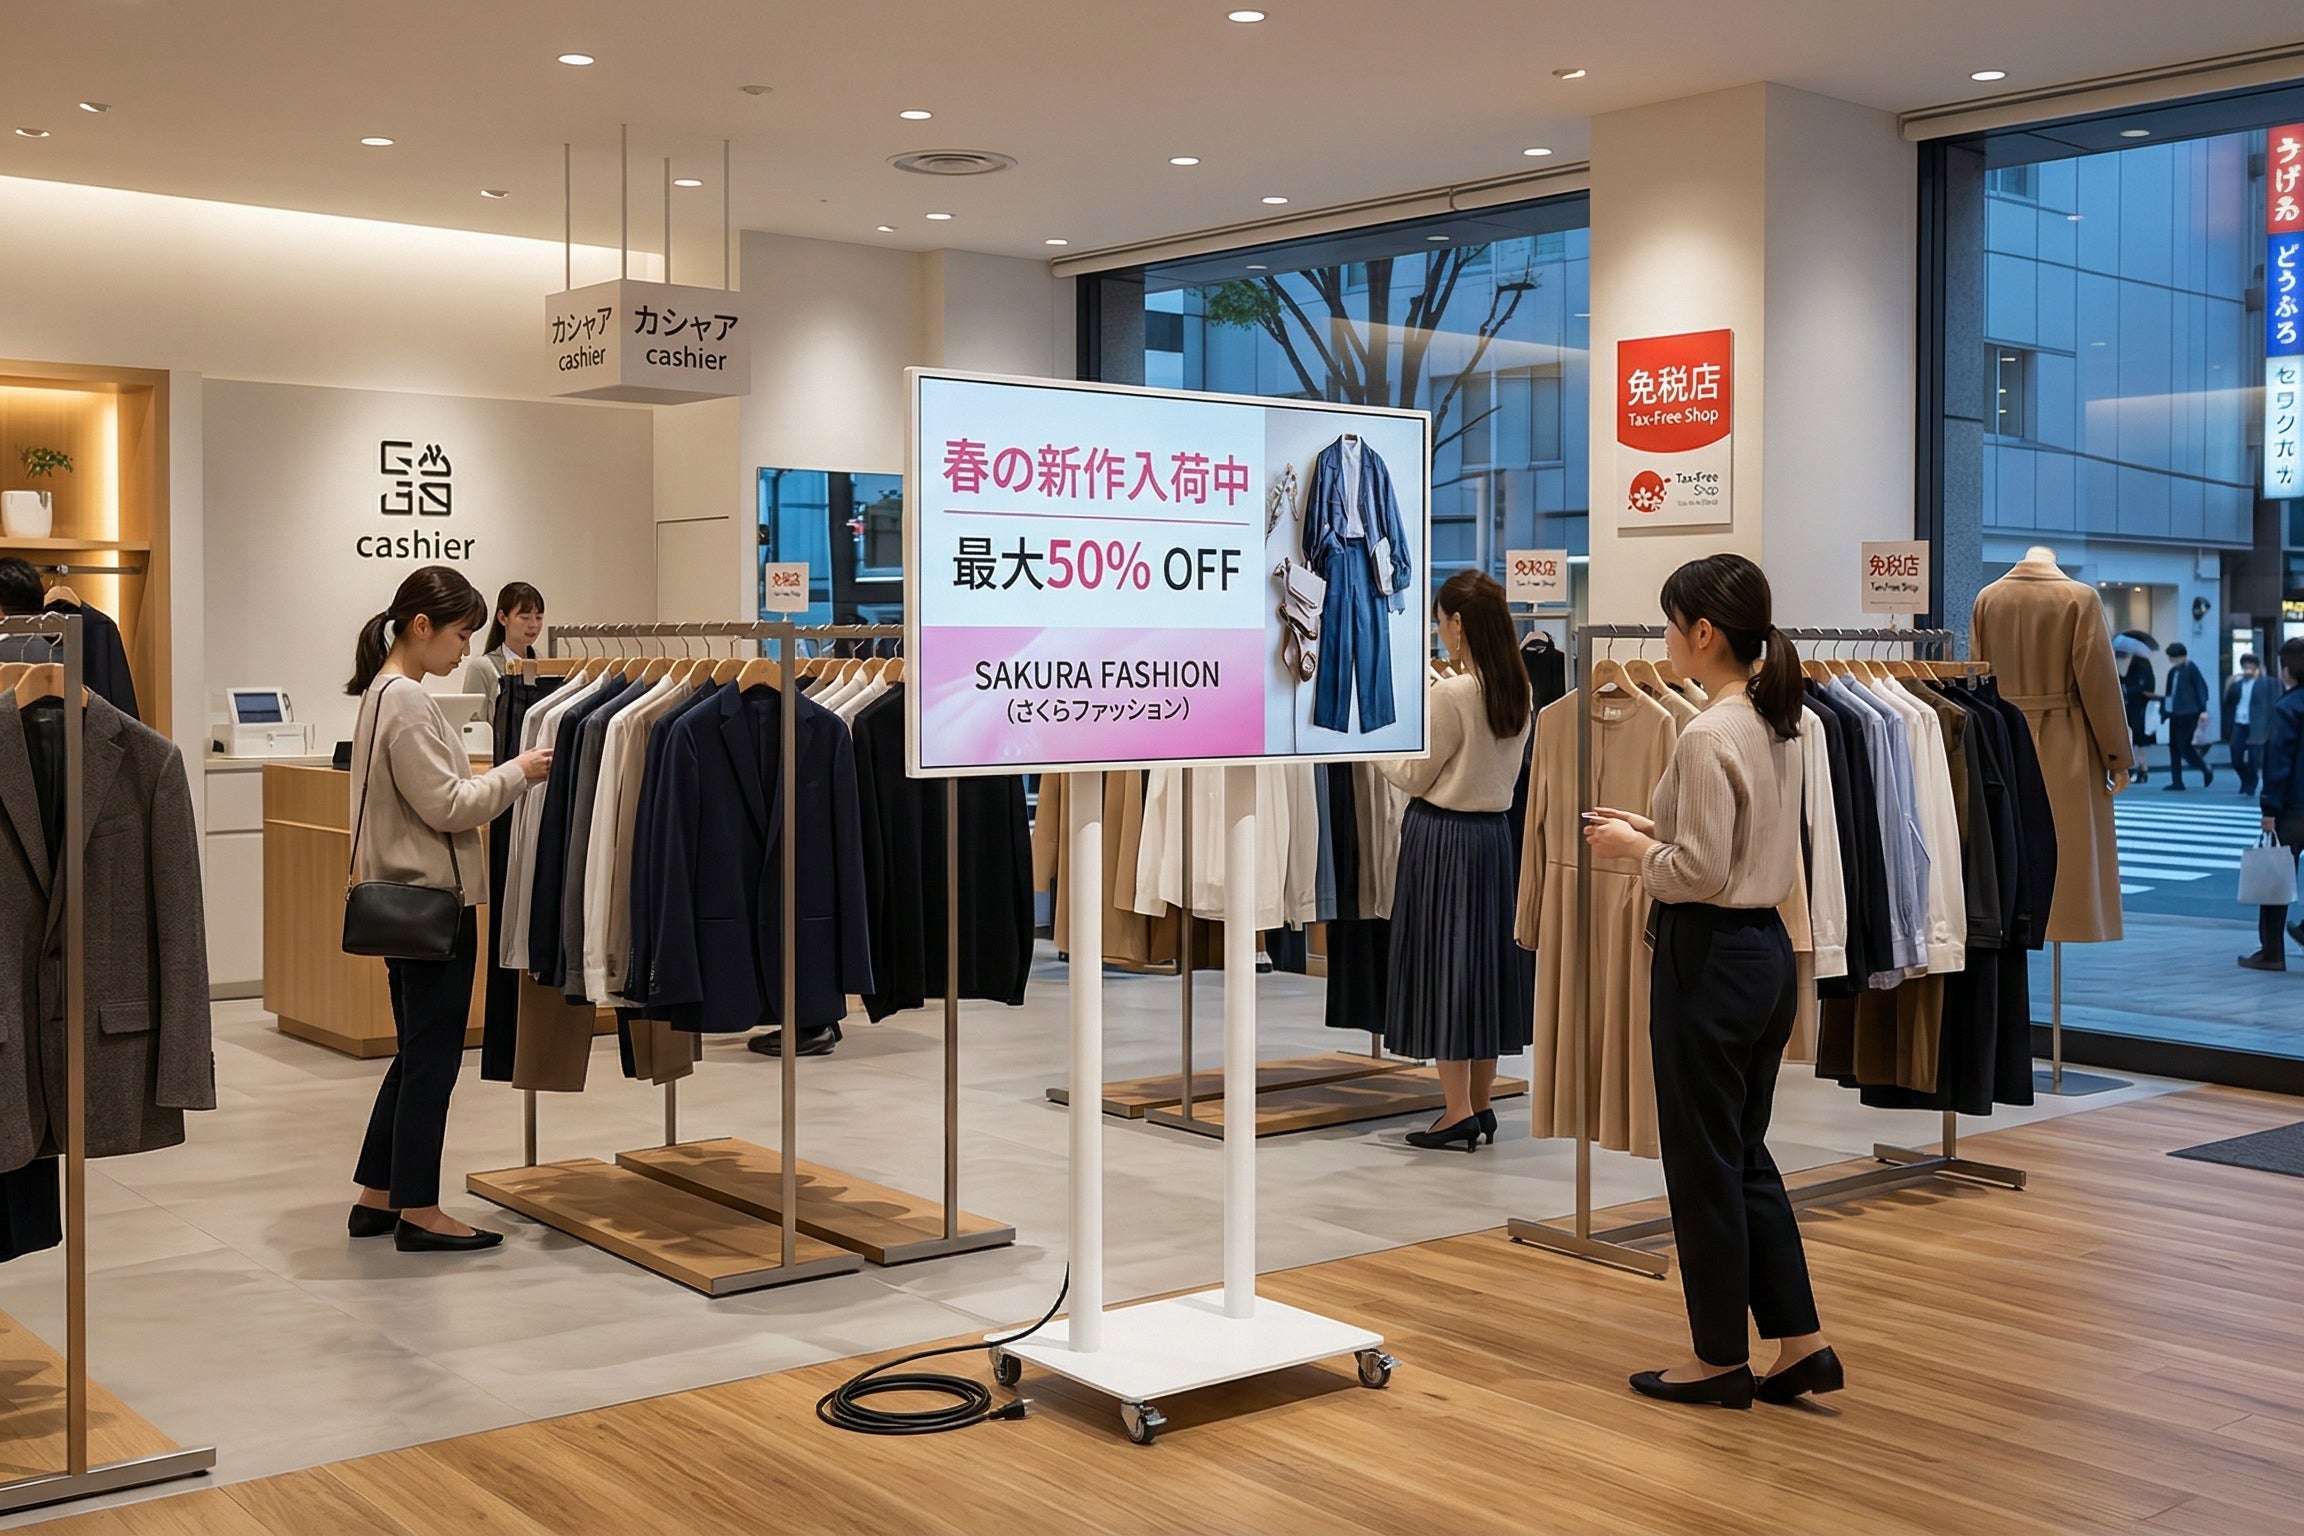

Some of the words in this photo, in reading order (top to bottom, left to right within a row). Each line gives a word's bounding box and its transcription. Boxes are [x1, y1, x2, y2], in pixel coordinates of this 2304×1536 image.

[552, 306, 612, 344] カシャア
[634, 305, 738, 342] カシャア
[558, 346, 606, 371] cashier
[645, 345, 727, 371] cashier
[1627, 362, 1721, 406] 免税店
[1628, 410, 1683, 427] Tax-Free
[1684, 406, 1719, 425] Shop
[943, 437, 1250, 507] 春の新作入荷中
[356, 529, 475, 560] cashier
[952, 536, 1151, 591] 最大50%
[1163, 546, 1242, 591] OFF
[975, 660, 1093, 691] SAKURA
[1101, 660, 1220, 689] FASHION
[1007, 696, 1190, 724] (さくらファッション)
